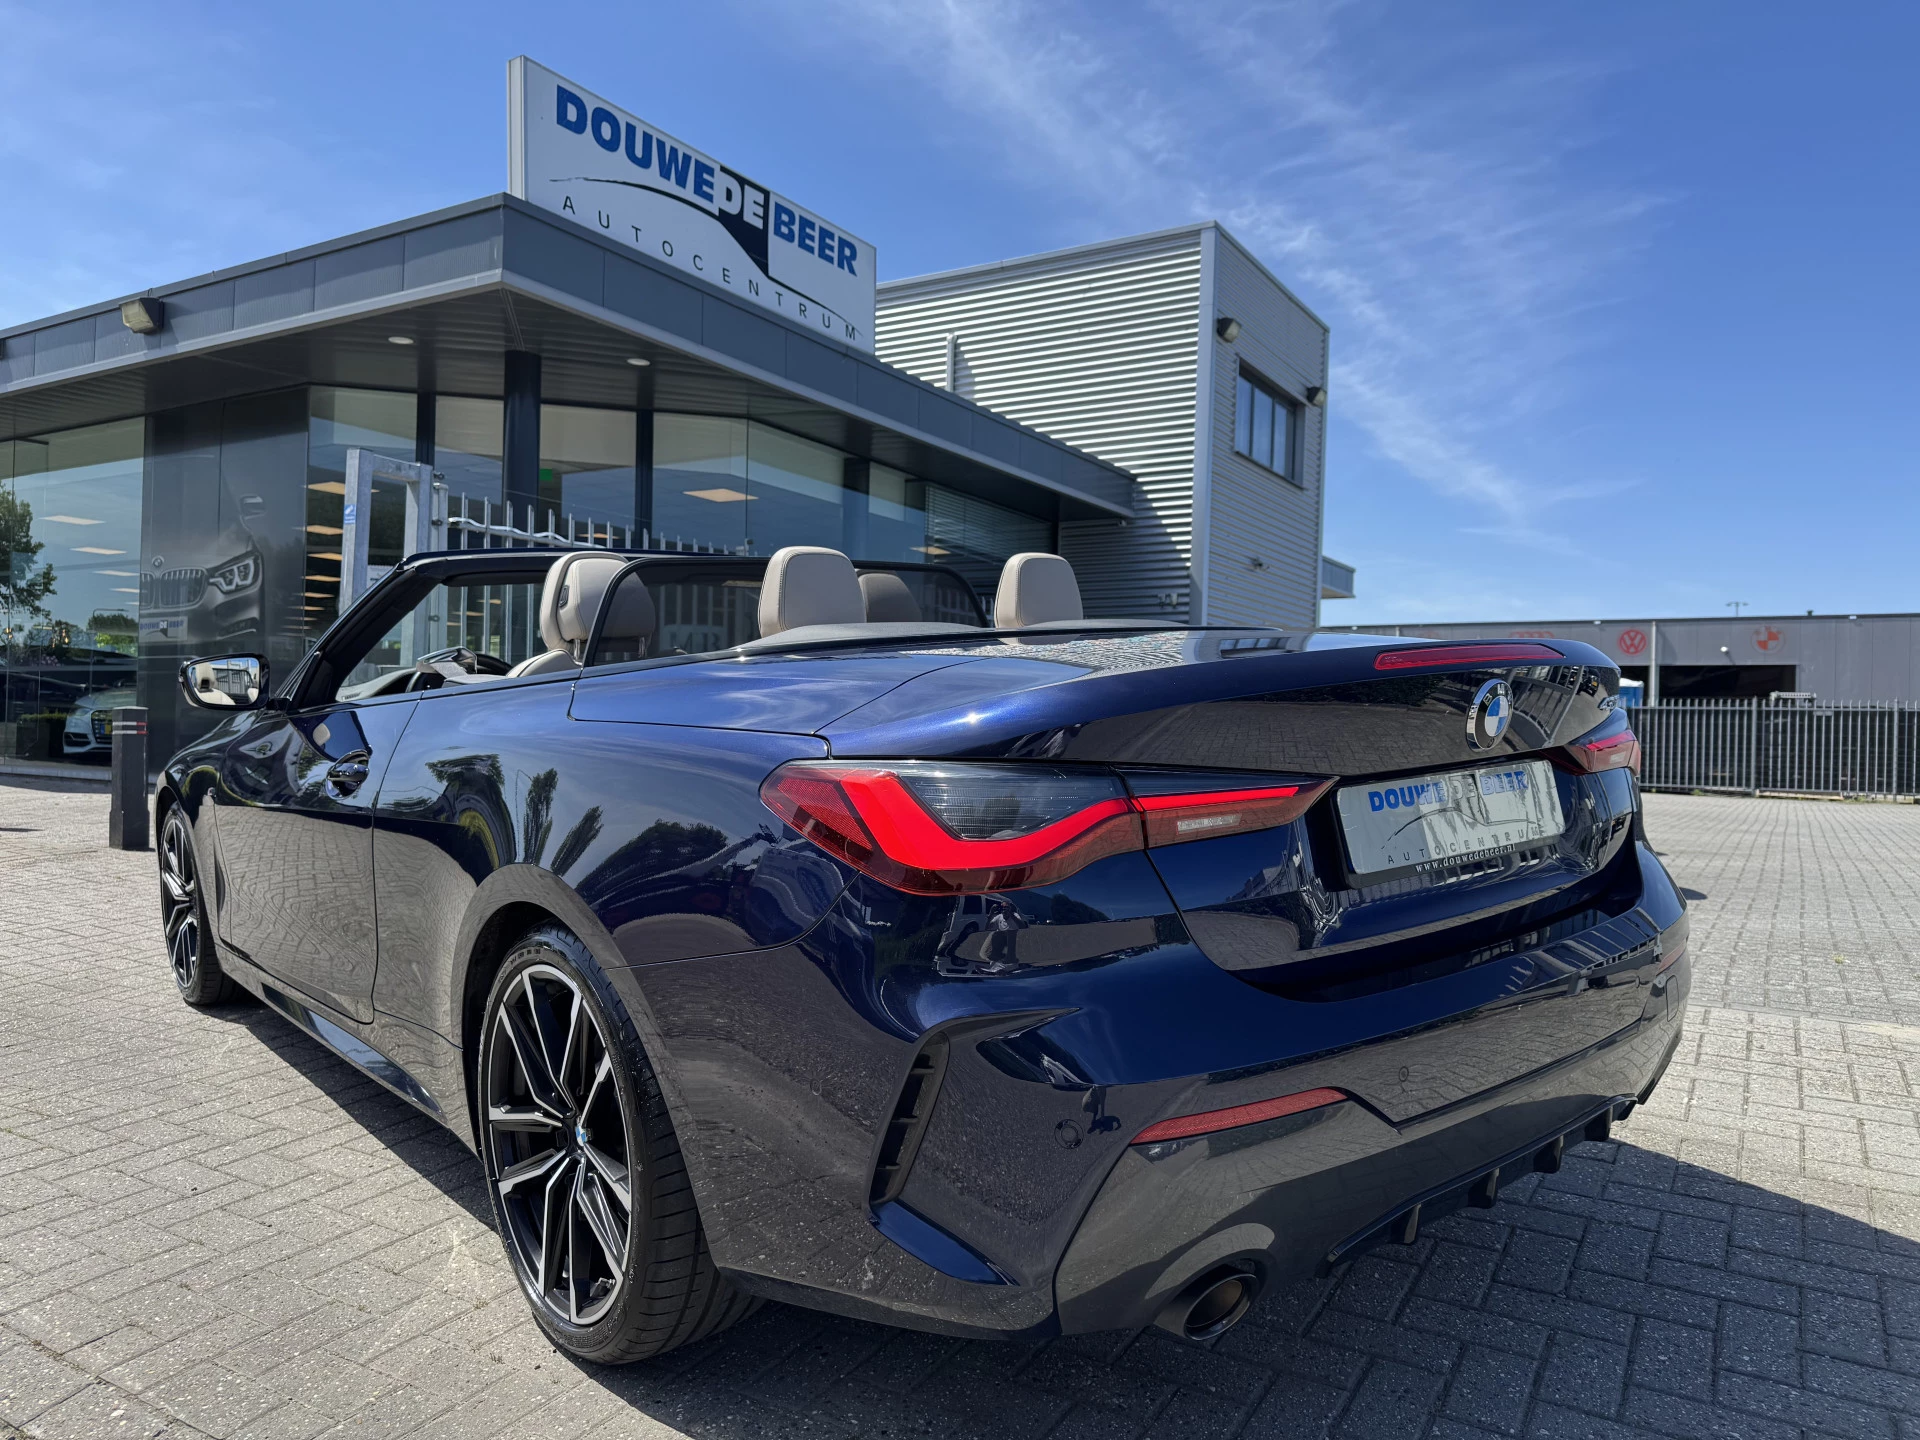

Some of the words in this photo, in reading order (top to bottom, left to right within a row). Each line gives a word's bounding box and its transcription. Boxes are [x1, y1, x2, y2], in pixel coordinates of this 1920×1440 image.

[556, 84, 716, 204] DOUWE
[717, 170, 764, 230] DE
[774, 201, 858, 277] BEER
[561, 194, 857, 341] AUTOCENTRUM
[1368, 781, 1447, 812] DOUWE
[1480, 770, 1529, 796] BEER
[1415, 843, 1516, 873] www.douwedebeer.nl
